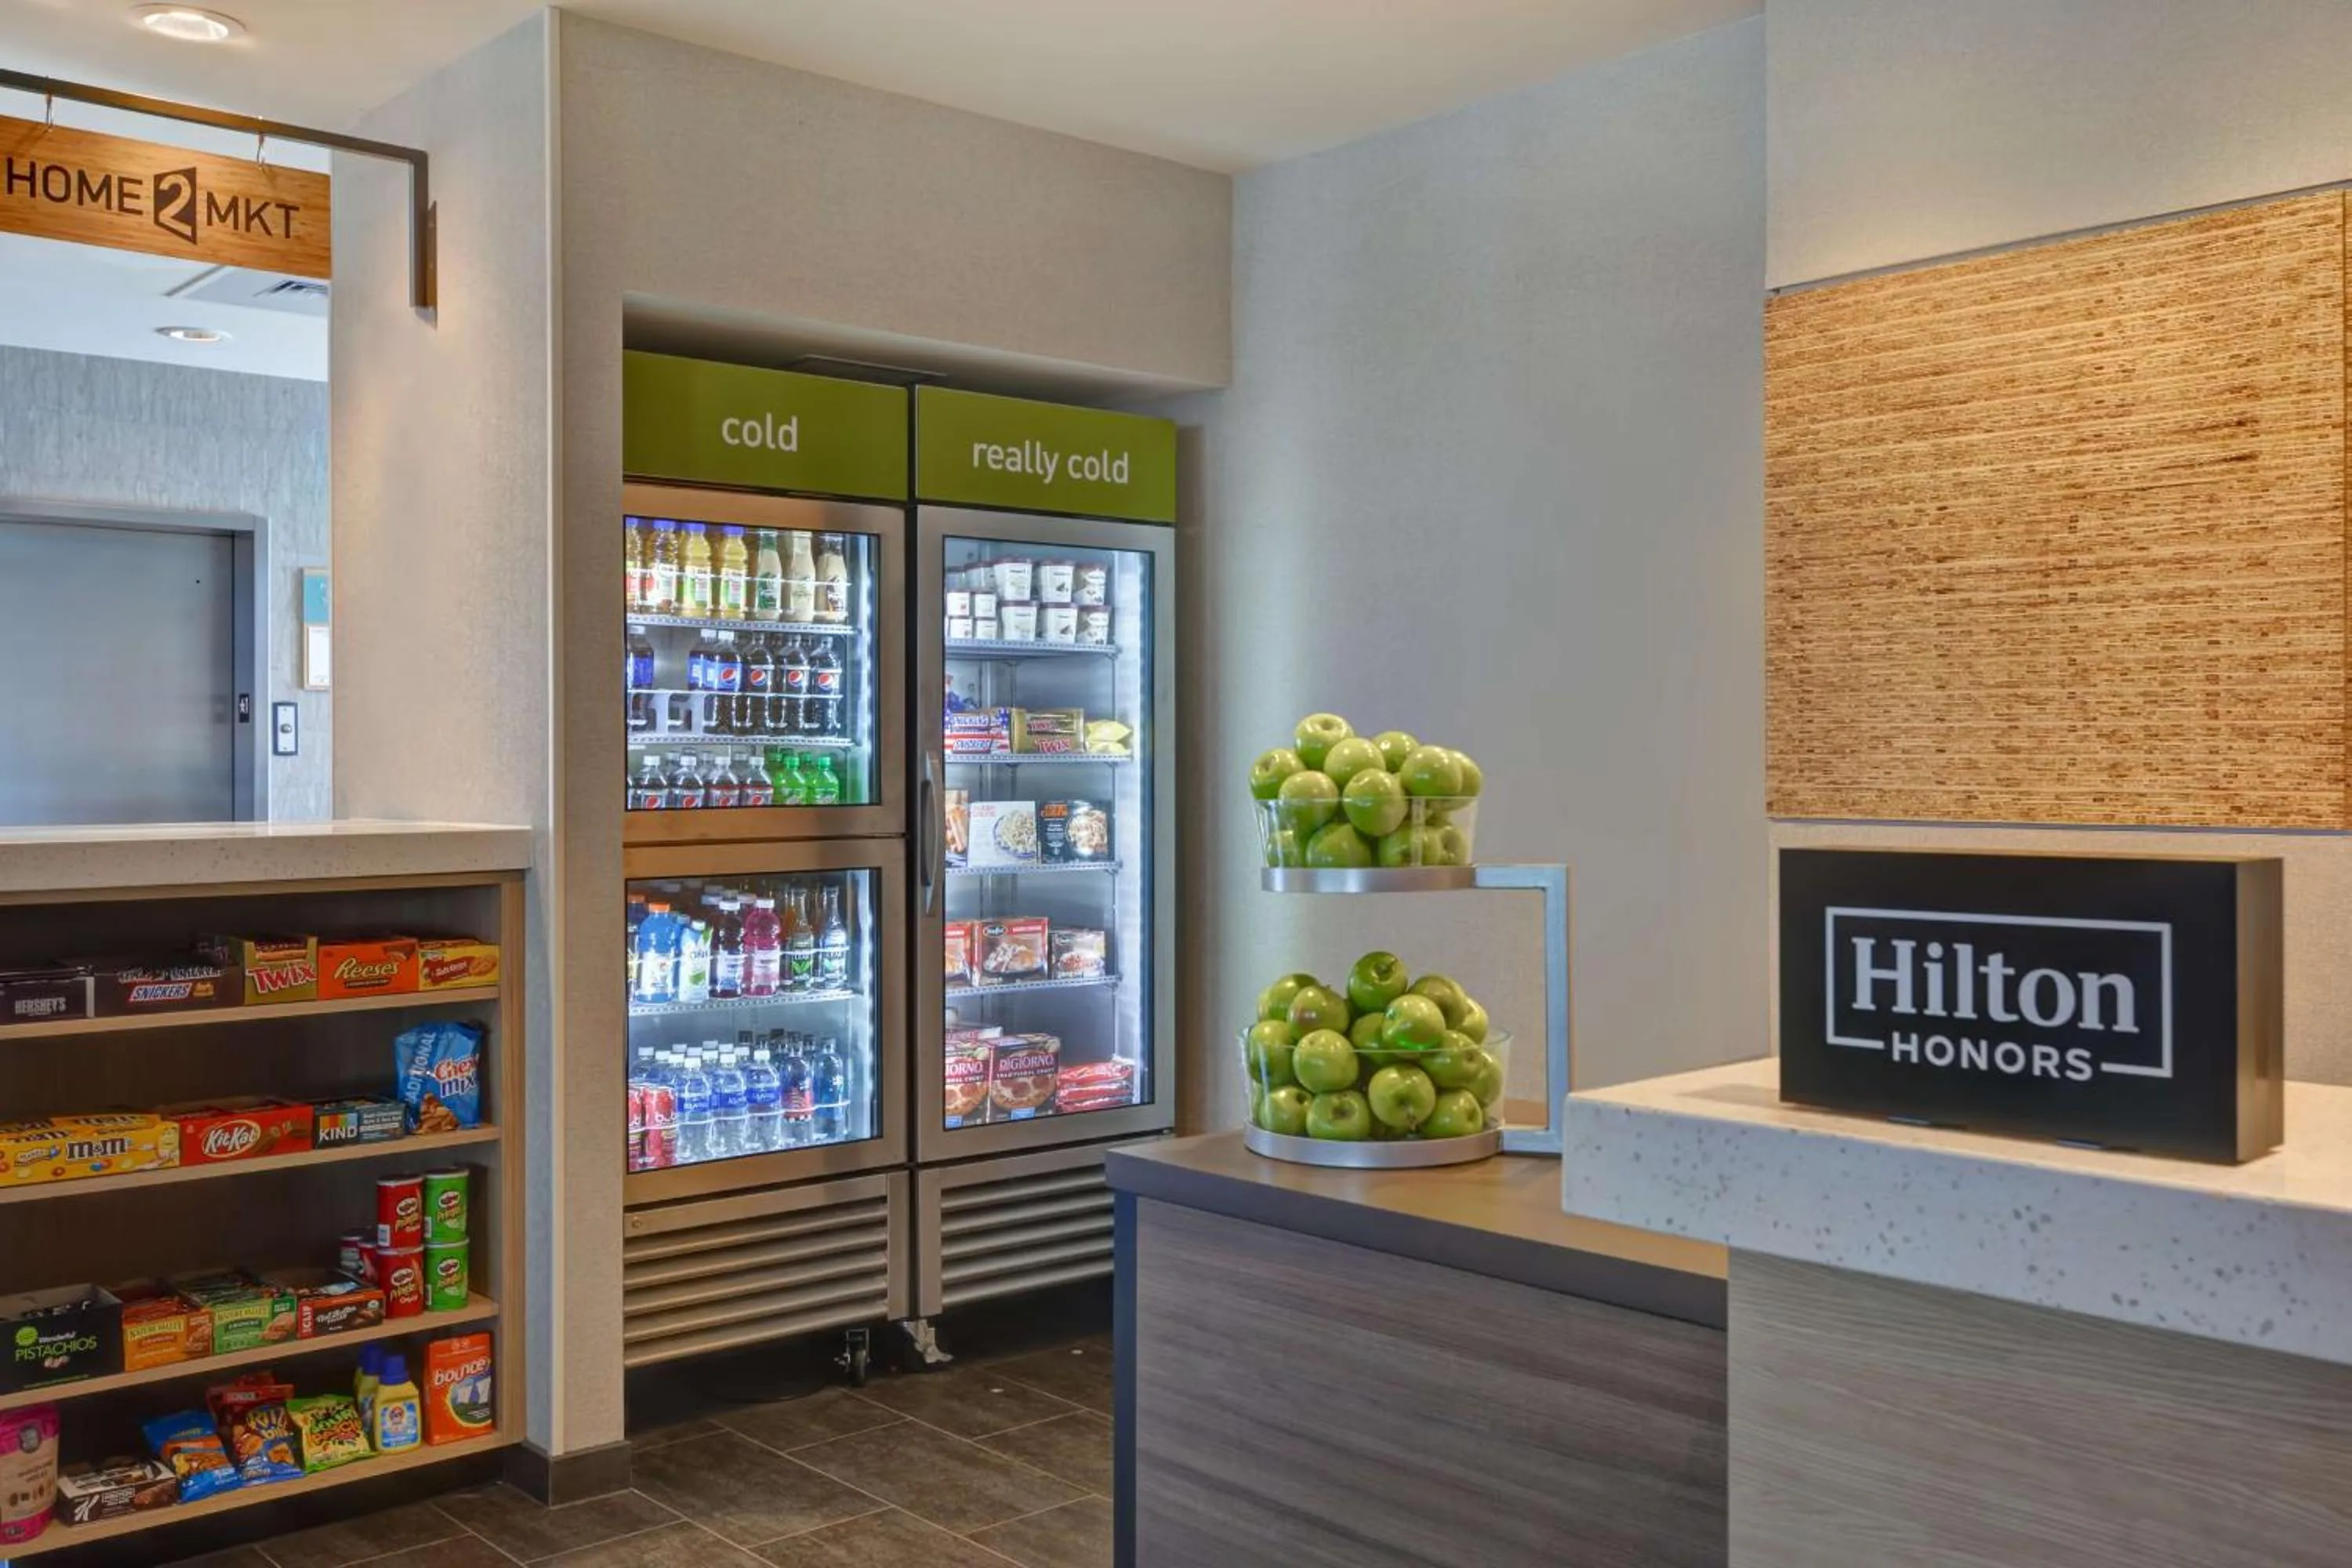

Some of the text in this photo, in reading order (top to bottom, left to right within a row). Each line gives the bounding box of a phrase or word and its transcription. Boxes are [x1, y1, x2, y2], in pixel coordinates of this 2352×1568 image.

[6, 157, 143, 216] HOME
[206, 191, 300, 239] MKT
[720, 413, 799, 452] cold
[972, 439, 1129, 485] really cold
[132, 983, 190, 1000] SNICKERS
[1850, 936, 2140, 1034] Hilton
[1891, 1031, 2093, 1082] HONORS
[319, 1127, 358, 1141] KIND
[15, 1336, 97, 1361] PISTACHIOS
[433, 1359, 485, 1387] bounce
